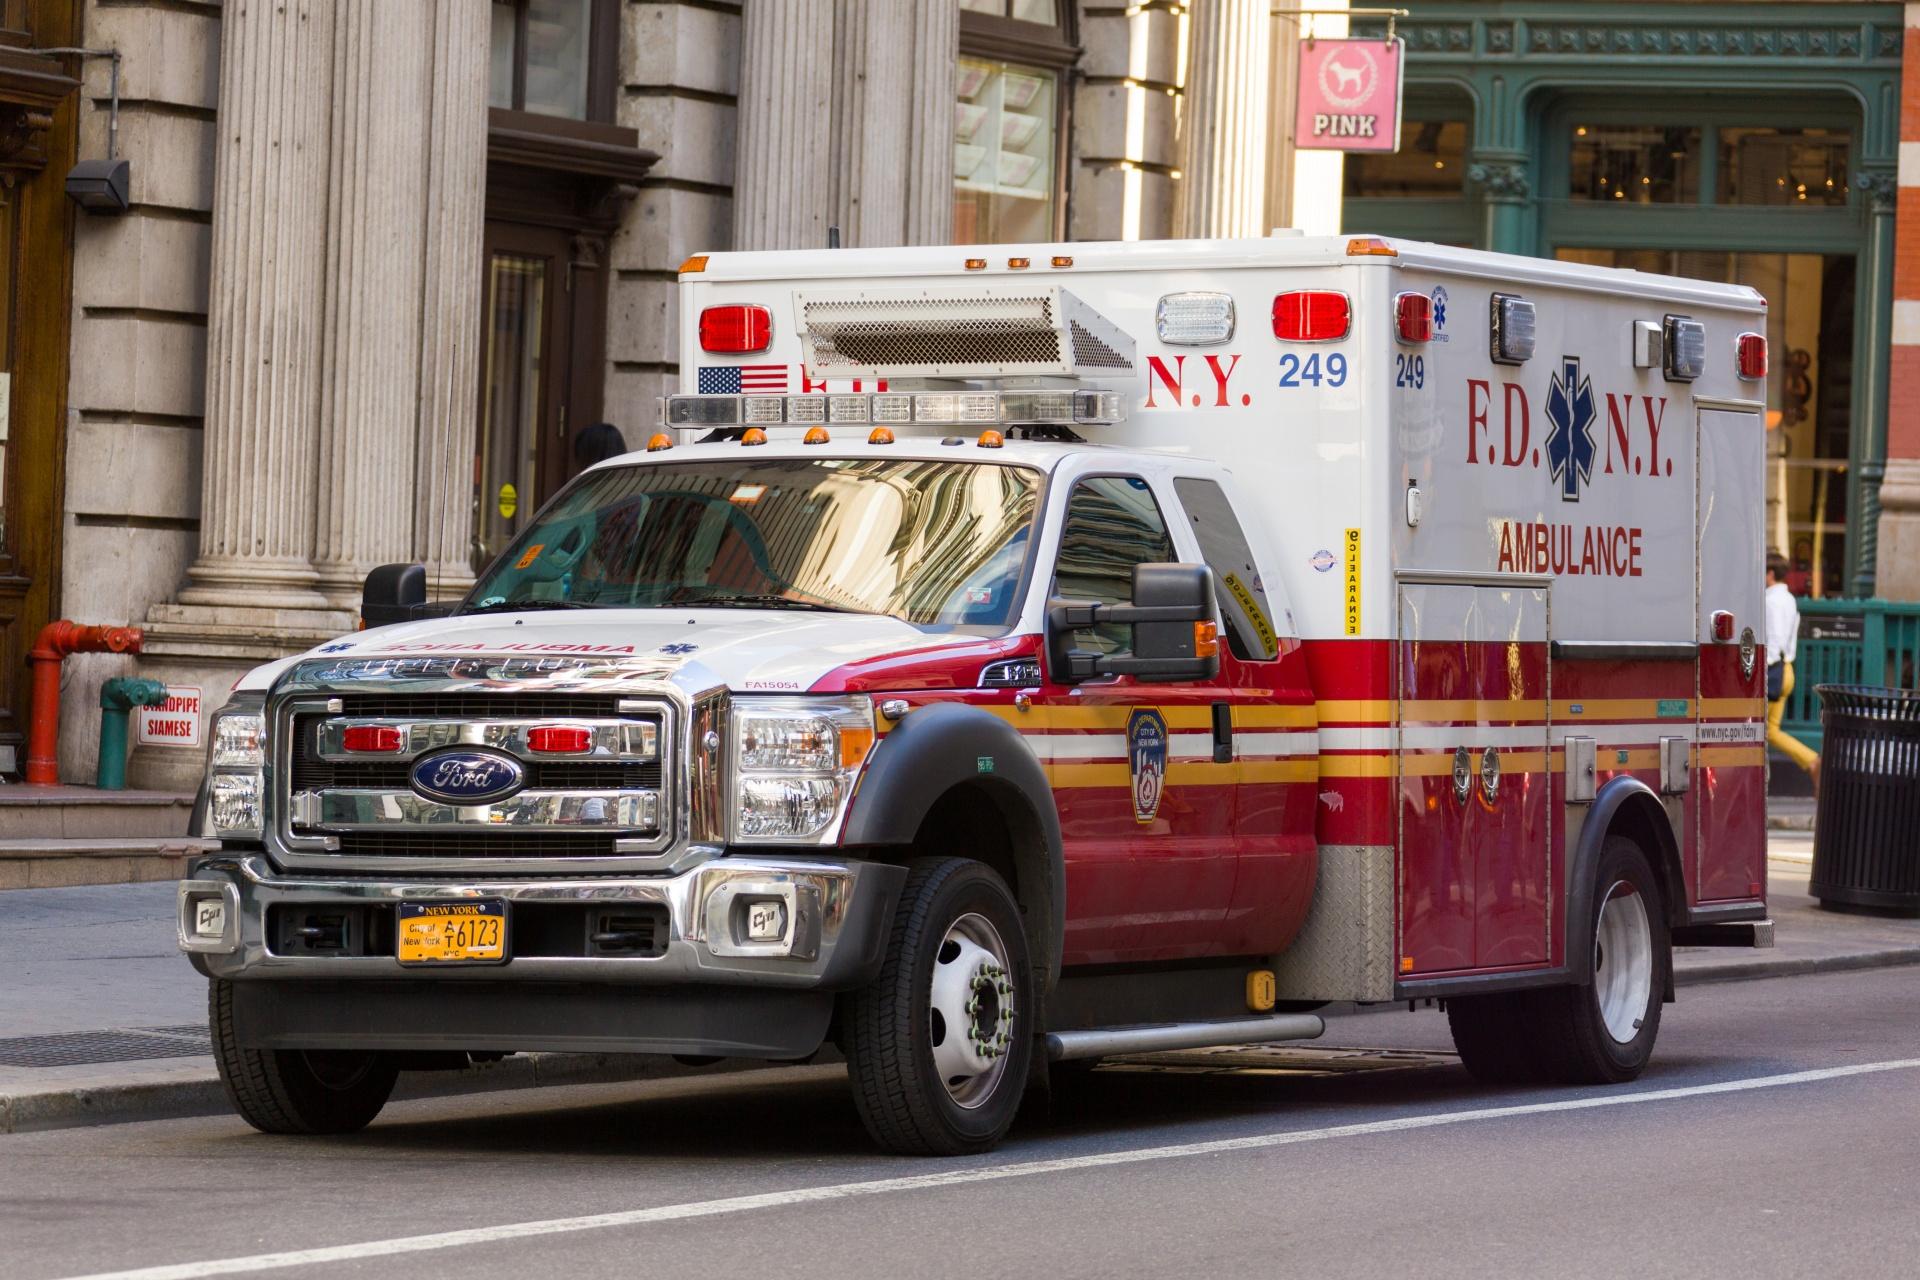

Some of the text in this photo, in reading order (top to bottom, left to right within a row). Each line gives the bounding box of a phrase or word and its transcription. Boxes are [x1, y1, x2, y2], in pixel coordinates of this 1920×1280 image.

[1313, 114, 1376, 137] PINK
[1144, 354, 1251, 408] N.Y.
[1279, 352, 1348, 388] 249
[1396, 353, 1425, 390] 249
[1466, 379, 1673, 477] F.D. N.Y.
[1498, 521, 1643, 577] AMBULANCE
[745, 681, 799, 689] FA15054
[143, 697, 199, 713] NDPIPE
[148, 719, 192, 737] SIAMESE
[1701, 725, 1757, 741] www.nyc.gov/fdny
[433, 760, 495, 787] Ford
[426, 906, 479, 916] NEW YORK
[409, 923, 436, 934] City of
[457, 918, 498, 948] 6123
[404, 937, 441, 946] New York
